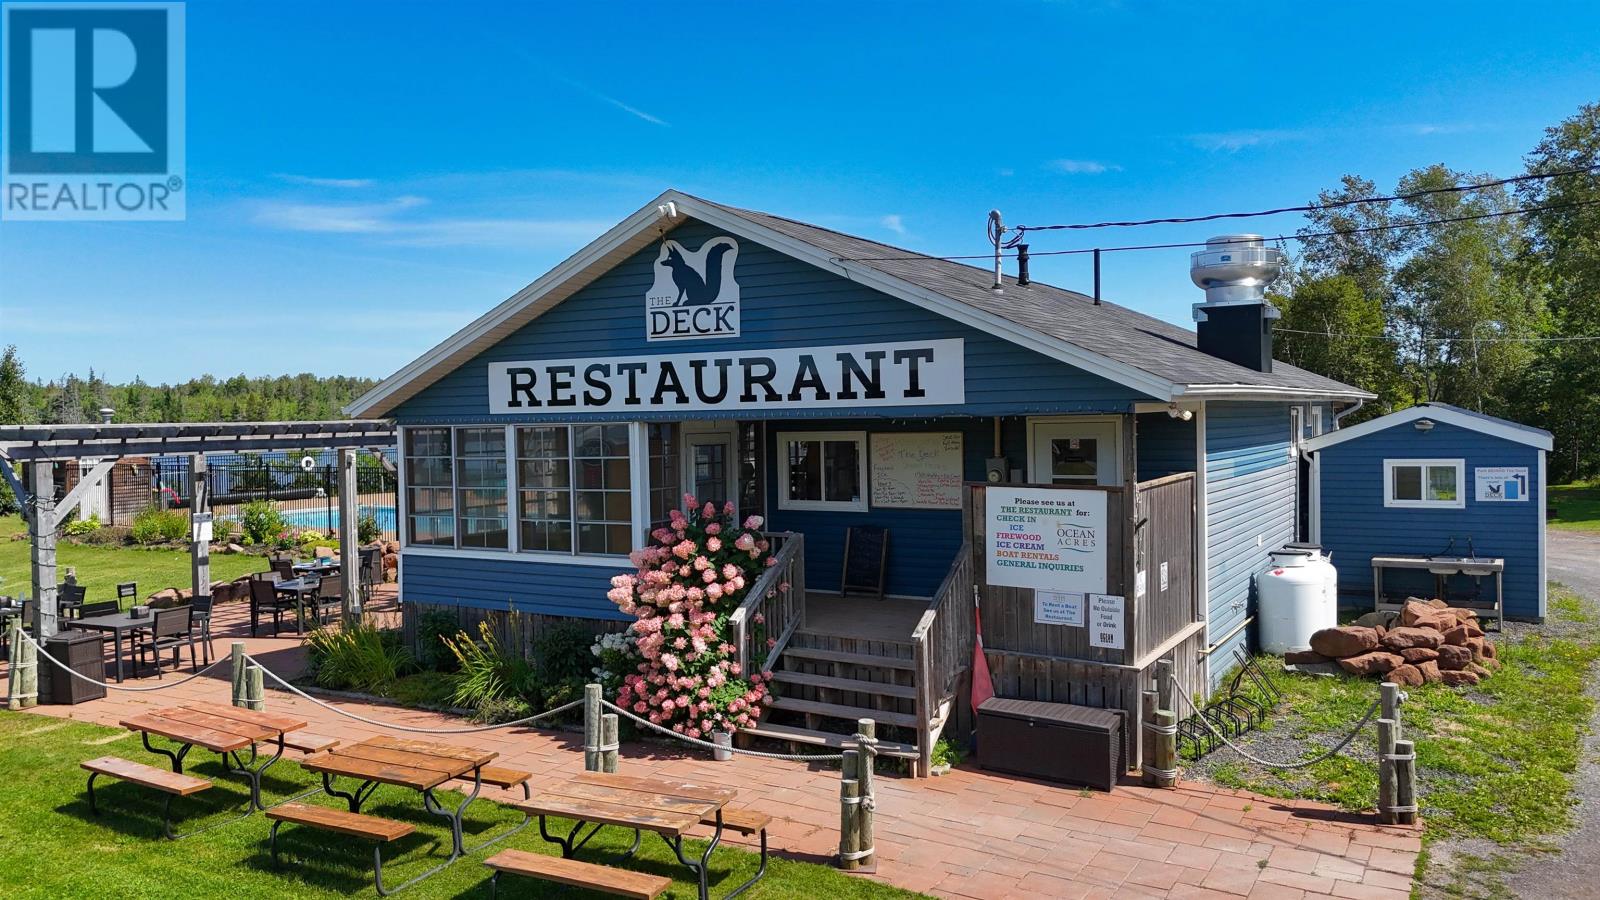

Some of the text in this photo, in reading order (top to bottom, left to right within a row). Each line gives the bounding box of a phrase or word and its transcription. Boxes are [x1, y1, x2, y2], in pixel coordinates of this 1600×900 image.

[649, 296, 672, 306] THE
[650, 305, 735, 335] DECK
[506, 348, 935, 407] RESTAURANT
[1001, 506, 1017, 514] THE
[1019, 507, 1072, 516] RESTAURANT
[996, 532, 1042, 541] FIREWOOD
[1057, 528, 1095, 538] OCEAN
[1013, 542, 1044, 550] CREAM
[1057, 538, 1096, 547] ACRES
[996, 550, 1059, 561] BOAT RENTALS
[997, 560, 1084, 572] GENERAL INQUIRIES
